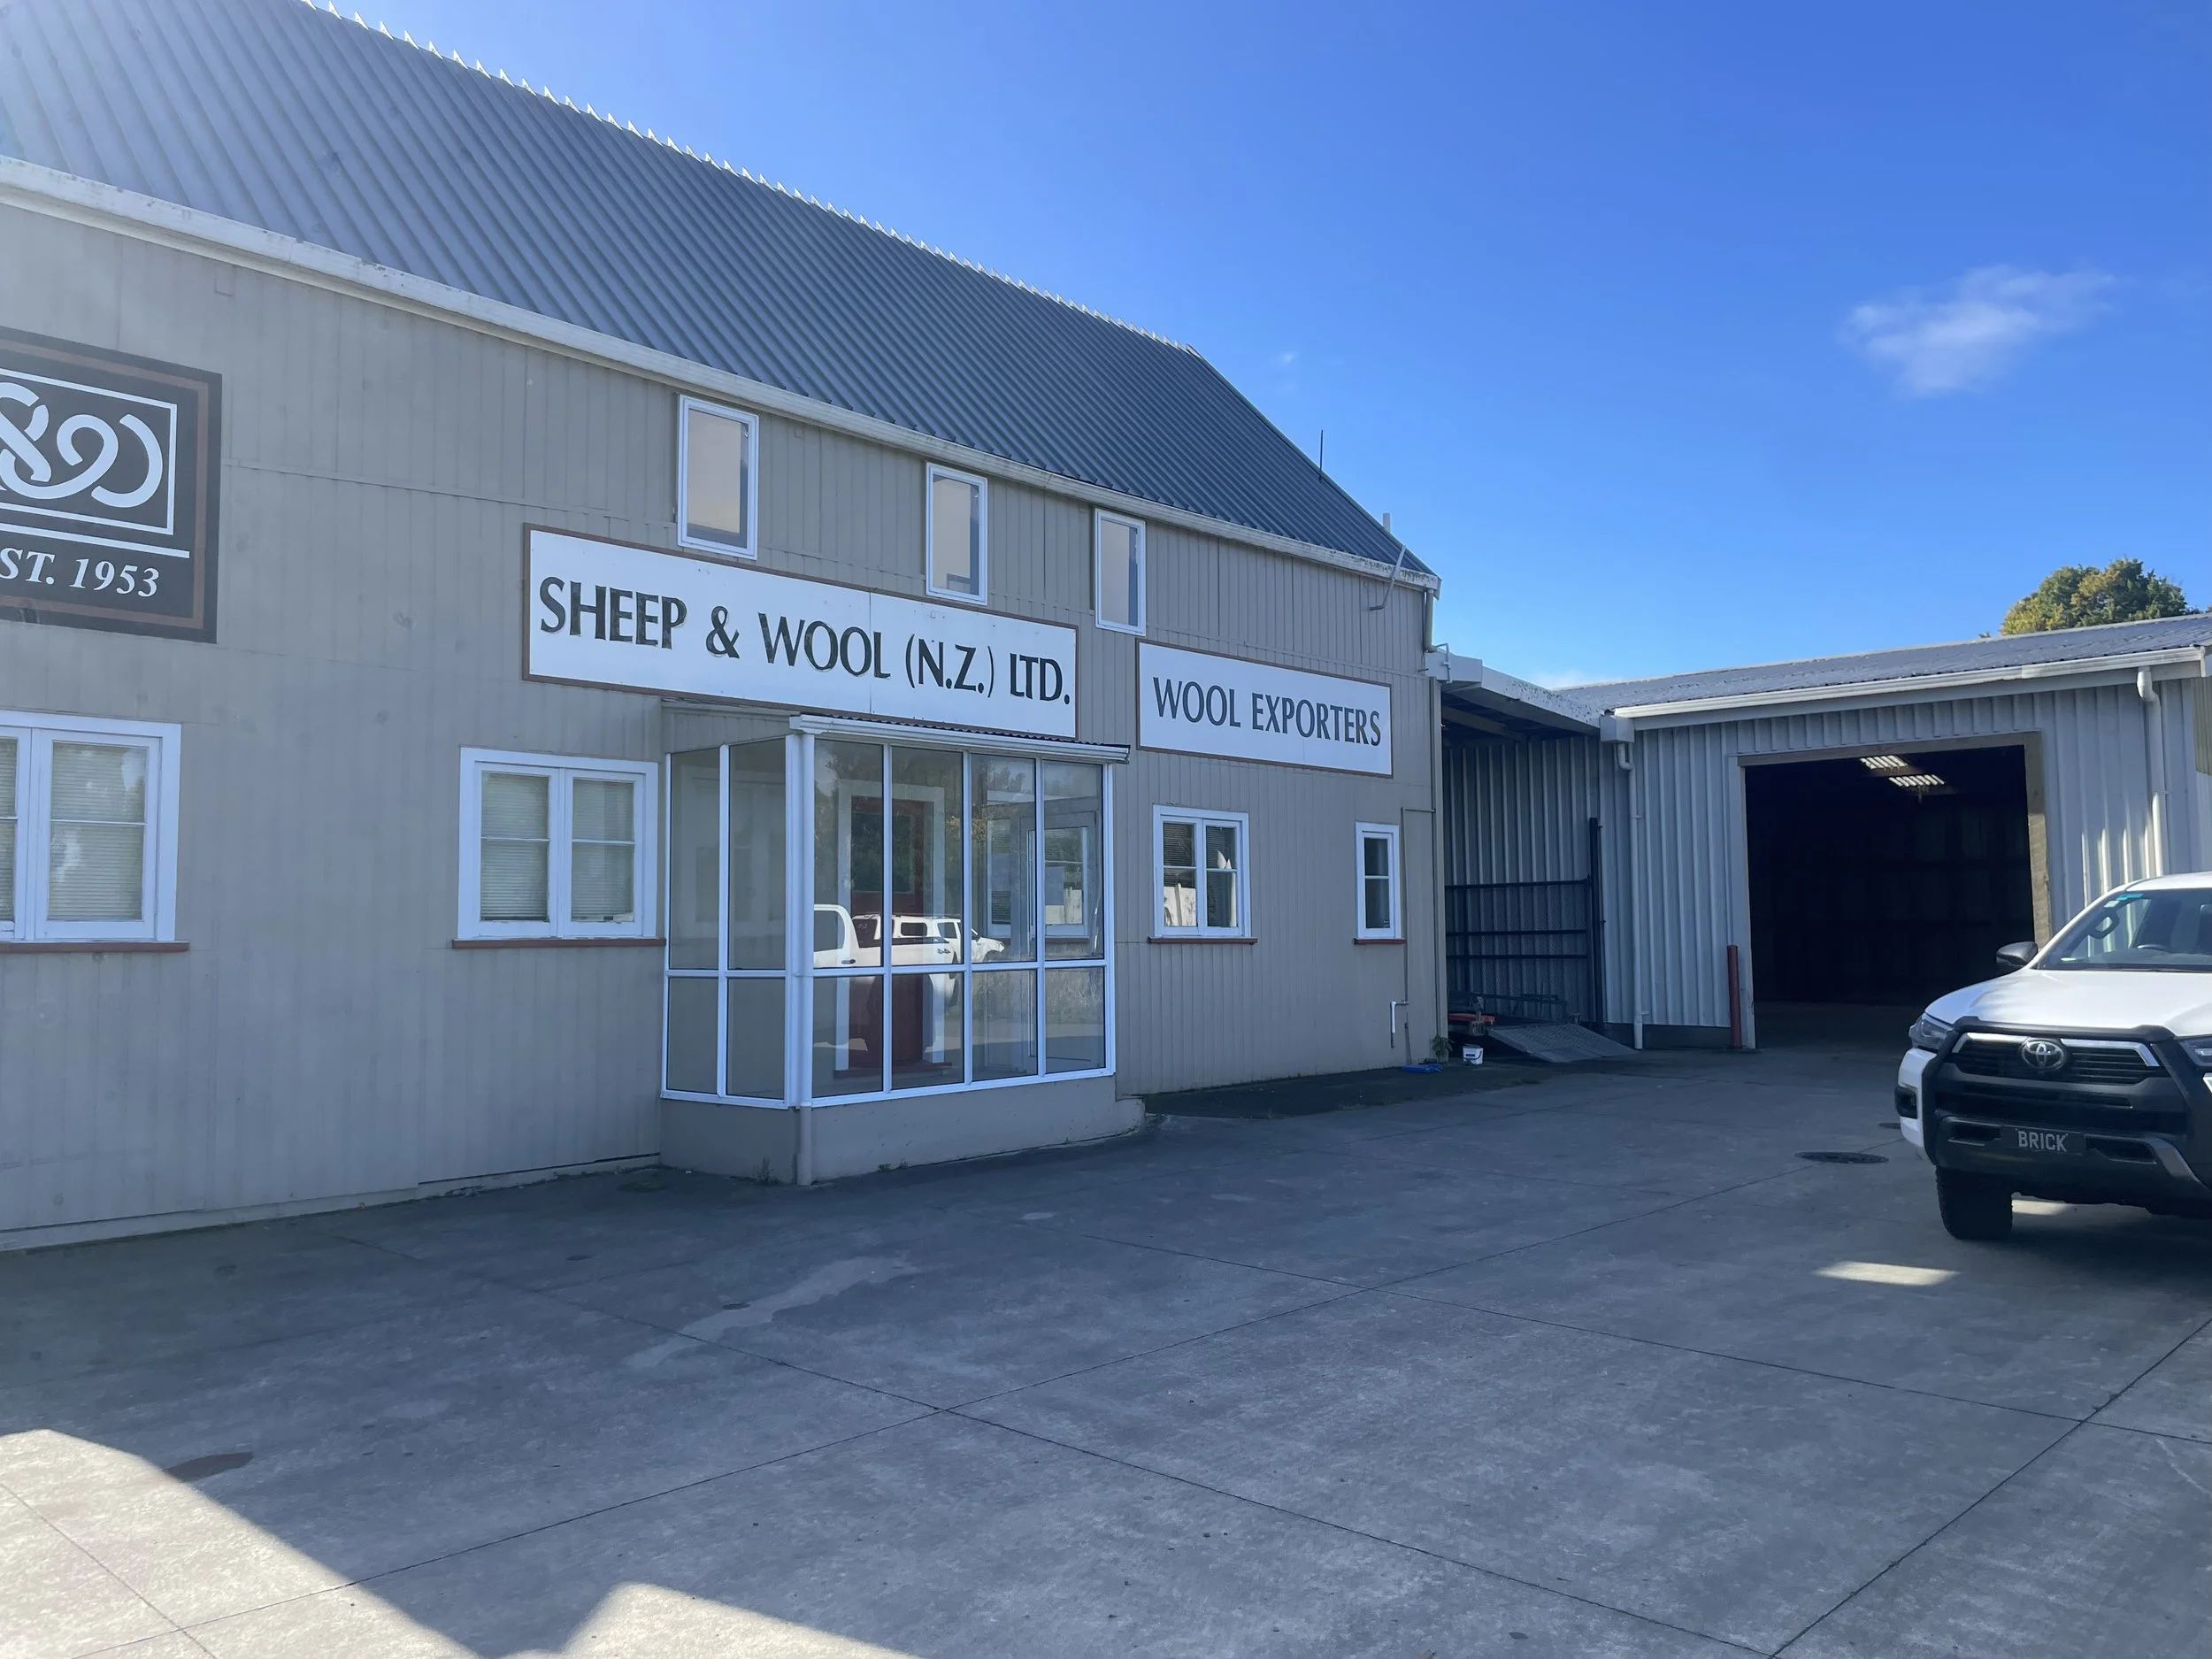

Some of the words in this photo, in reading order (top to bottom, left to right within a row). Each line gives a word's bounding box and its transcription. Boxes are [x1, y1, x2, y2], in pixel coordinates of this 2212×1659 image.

[68, 557, 160, 597] 1953
[538, 575, 687, 650] SHEEP
[705, 605, 741, 660] &
[758, 612, 891, 679] WOOL
[905, 634, 995, 698] (N.Z.)
[1009, 653, 1071, 705] LTD.
[1152, 676, 1241, 728] WOOL
[1251, 692, 1381, 747] EXPORTERS
[2017, 1130, 2068, 1151] BRICK
